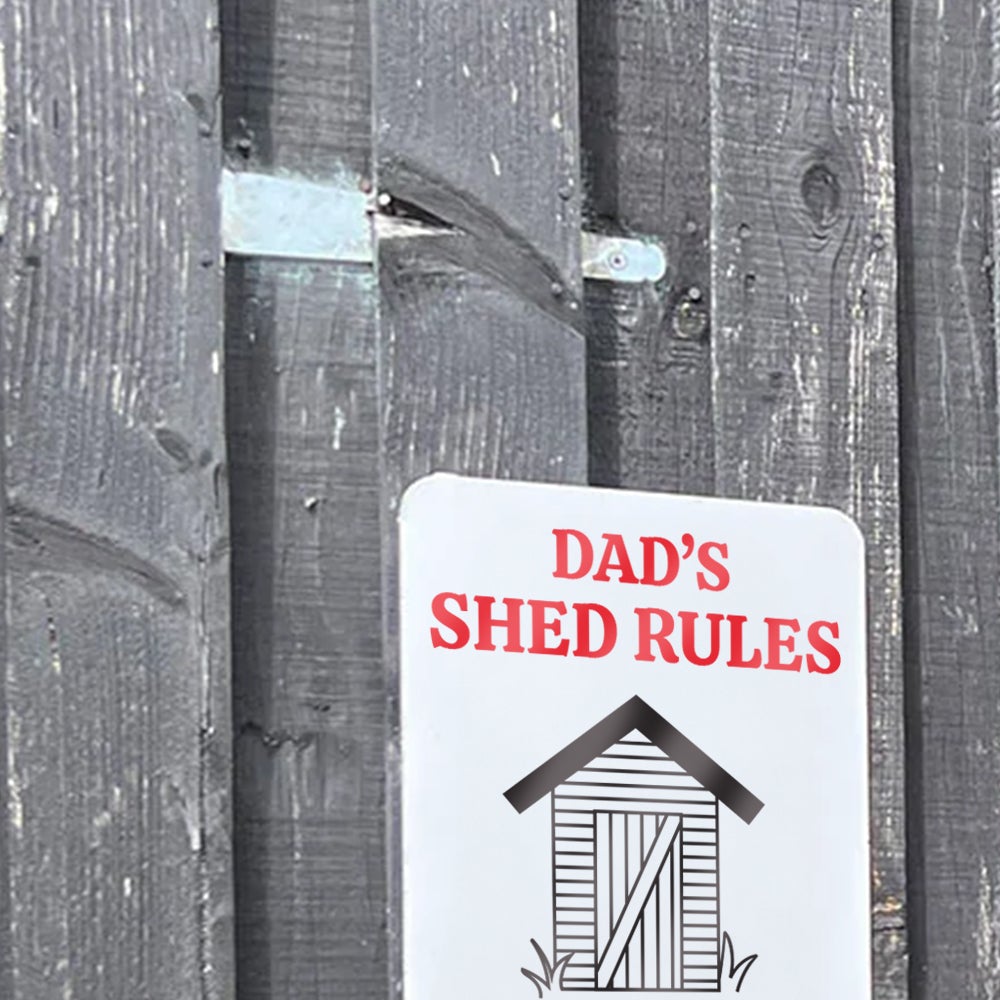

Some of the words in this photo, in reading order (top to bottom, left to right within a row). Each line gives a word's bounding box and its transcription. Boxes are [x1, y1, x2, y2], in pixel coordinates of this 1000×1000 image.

[552, 528, 730, 592] DAD’S
[429, 591, 618, 659] SHED
[634, 607, 842, 675] RULES
